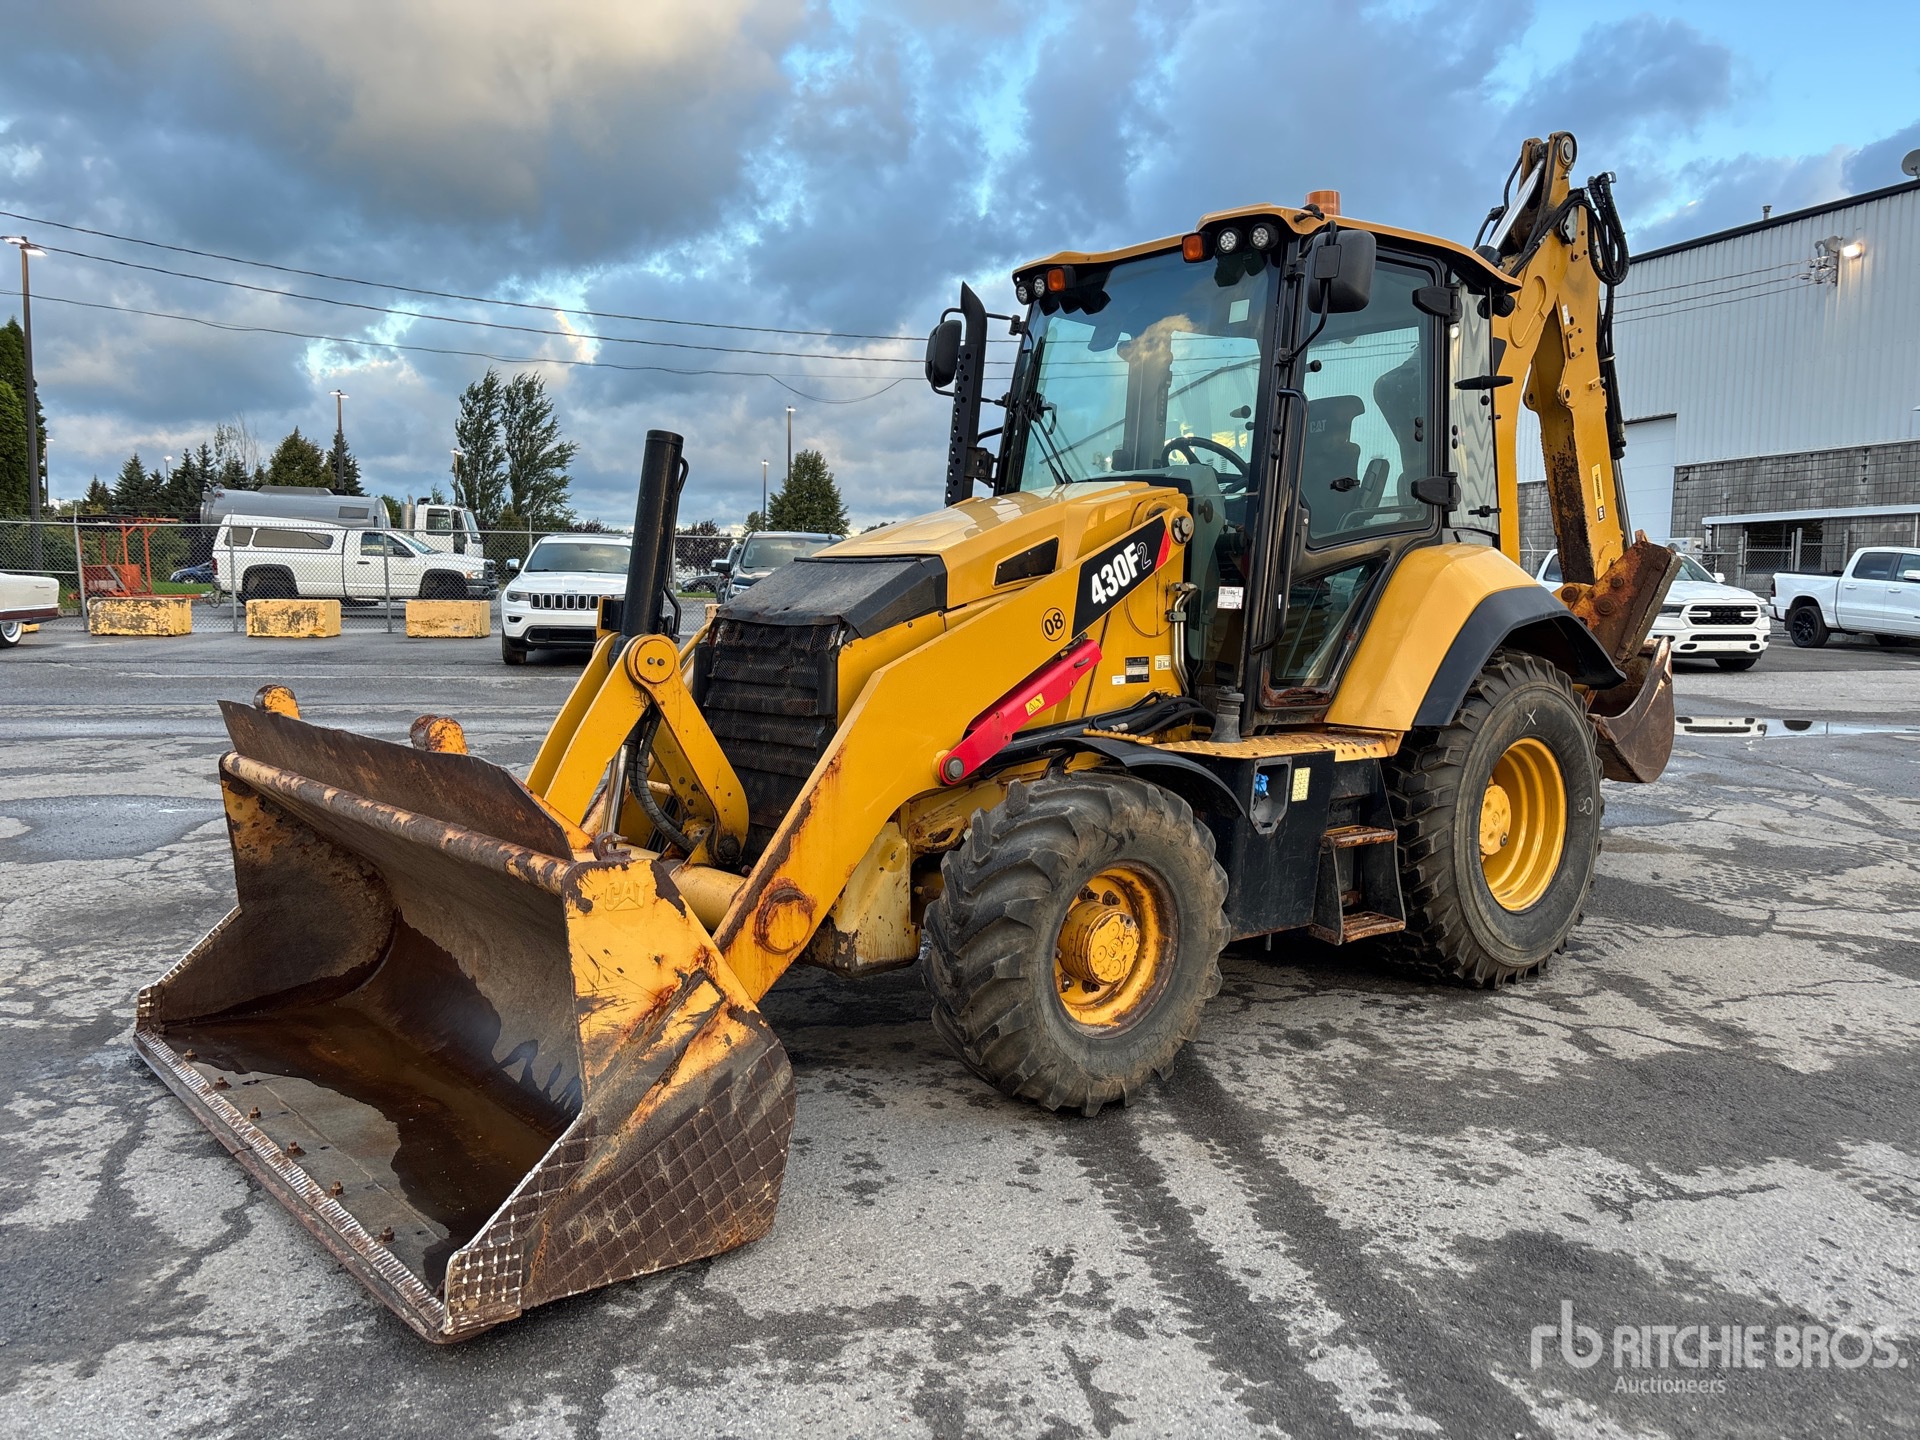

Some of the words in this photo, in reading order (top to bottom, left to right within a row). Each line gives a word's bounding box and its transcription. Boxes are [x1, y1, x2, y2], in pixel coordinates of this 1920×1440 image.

[1309, 419, 1327, 434] CAT
[1091, 541, 1152, 605] 430F2
[1044, 612, 1064, 636] 08
[604, 880, 650, 911] CAT
